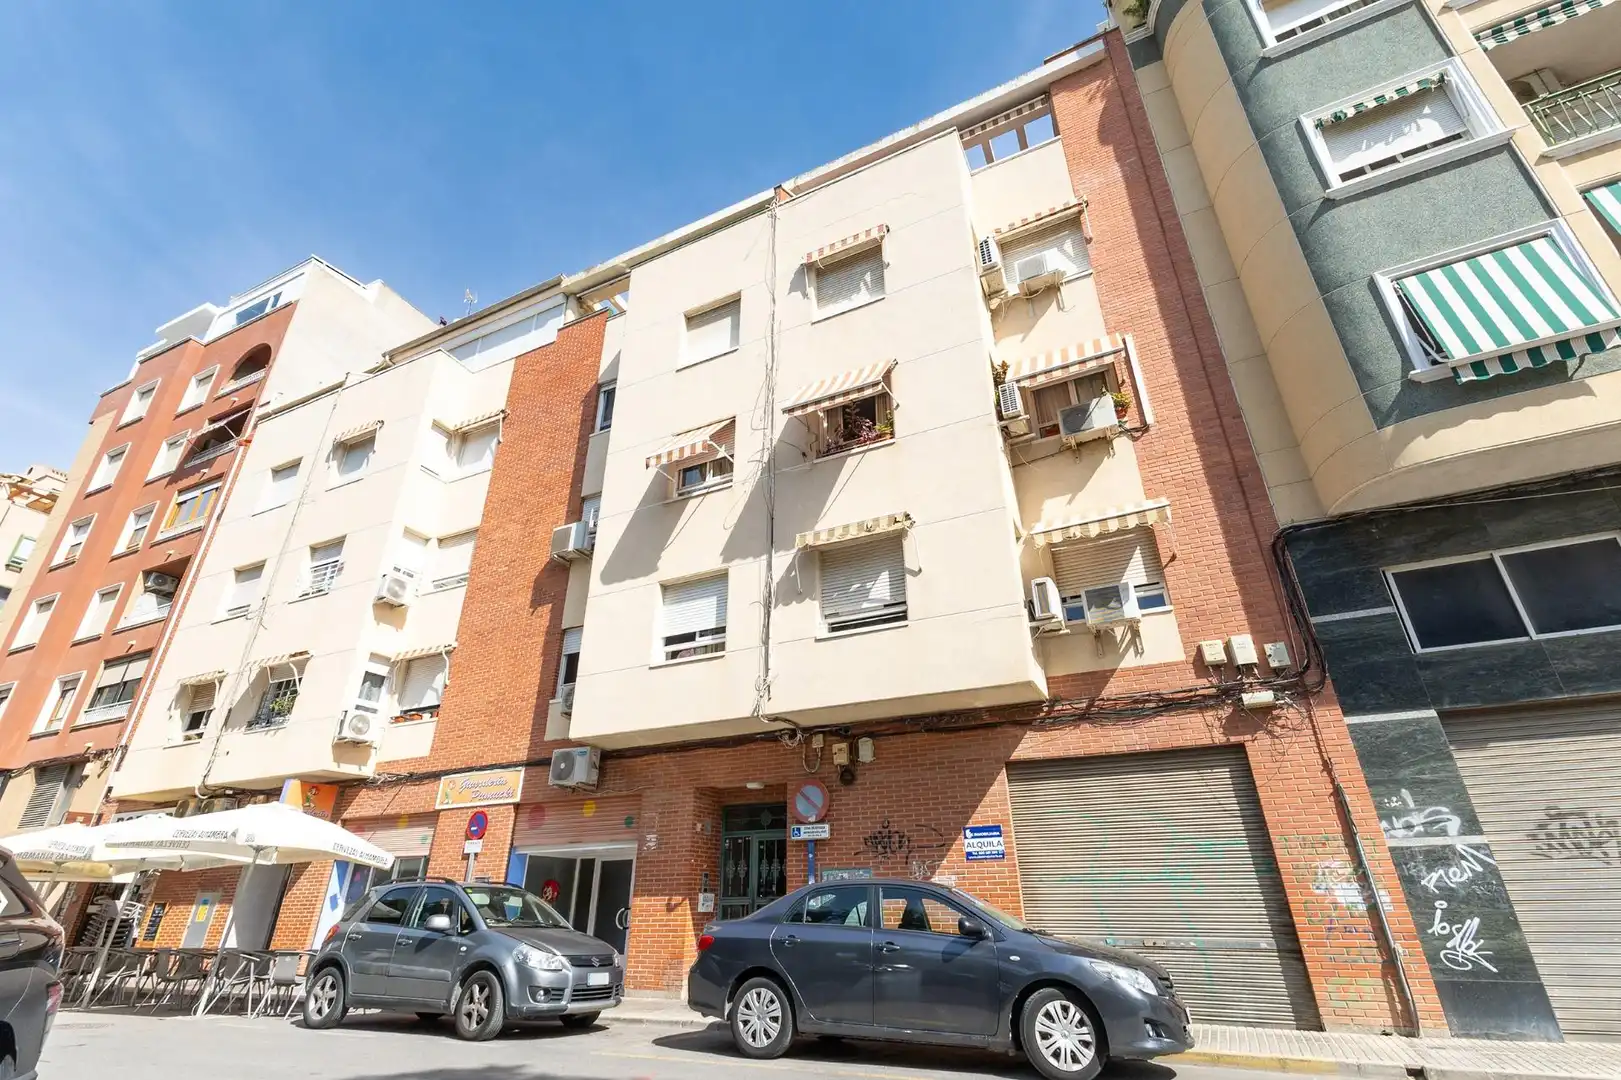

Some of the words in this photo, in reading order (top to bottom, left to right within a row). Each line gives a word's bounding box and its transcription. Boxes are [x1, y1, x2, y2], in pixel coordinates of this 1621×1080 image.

[197, 829, 228, 839] ALHAMBRA
[966, 840, 1003, 849] ALQUILA
[358, 851, 389, 865] ALHAMBRA
